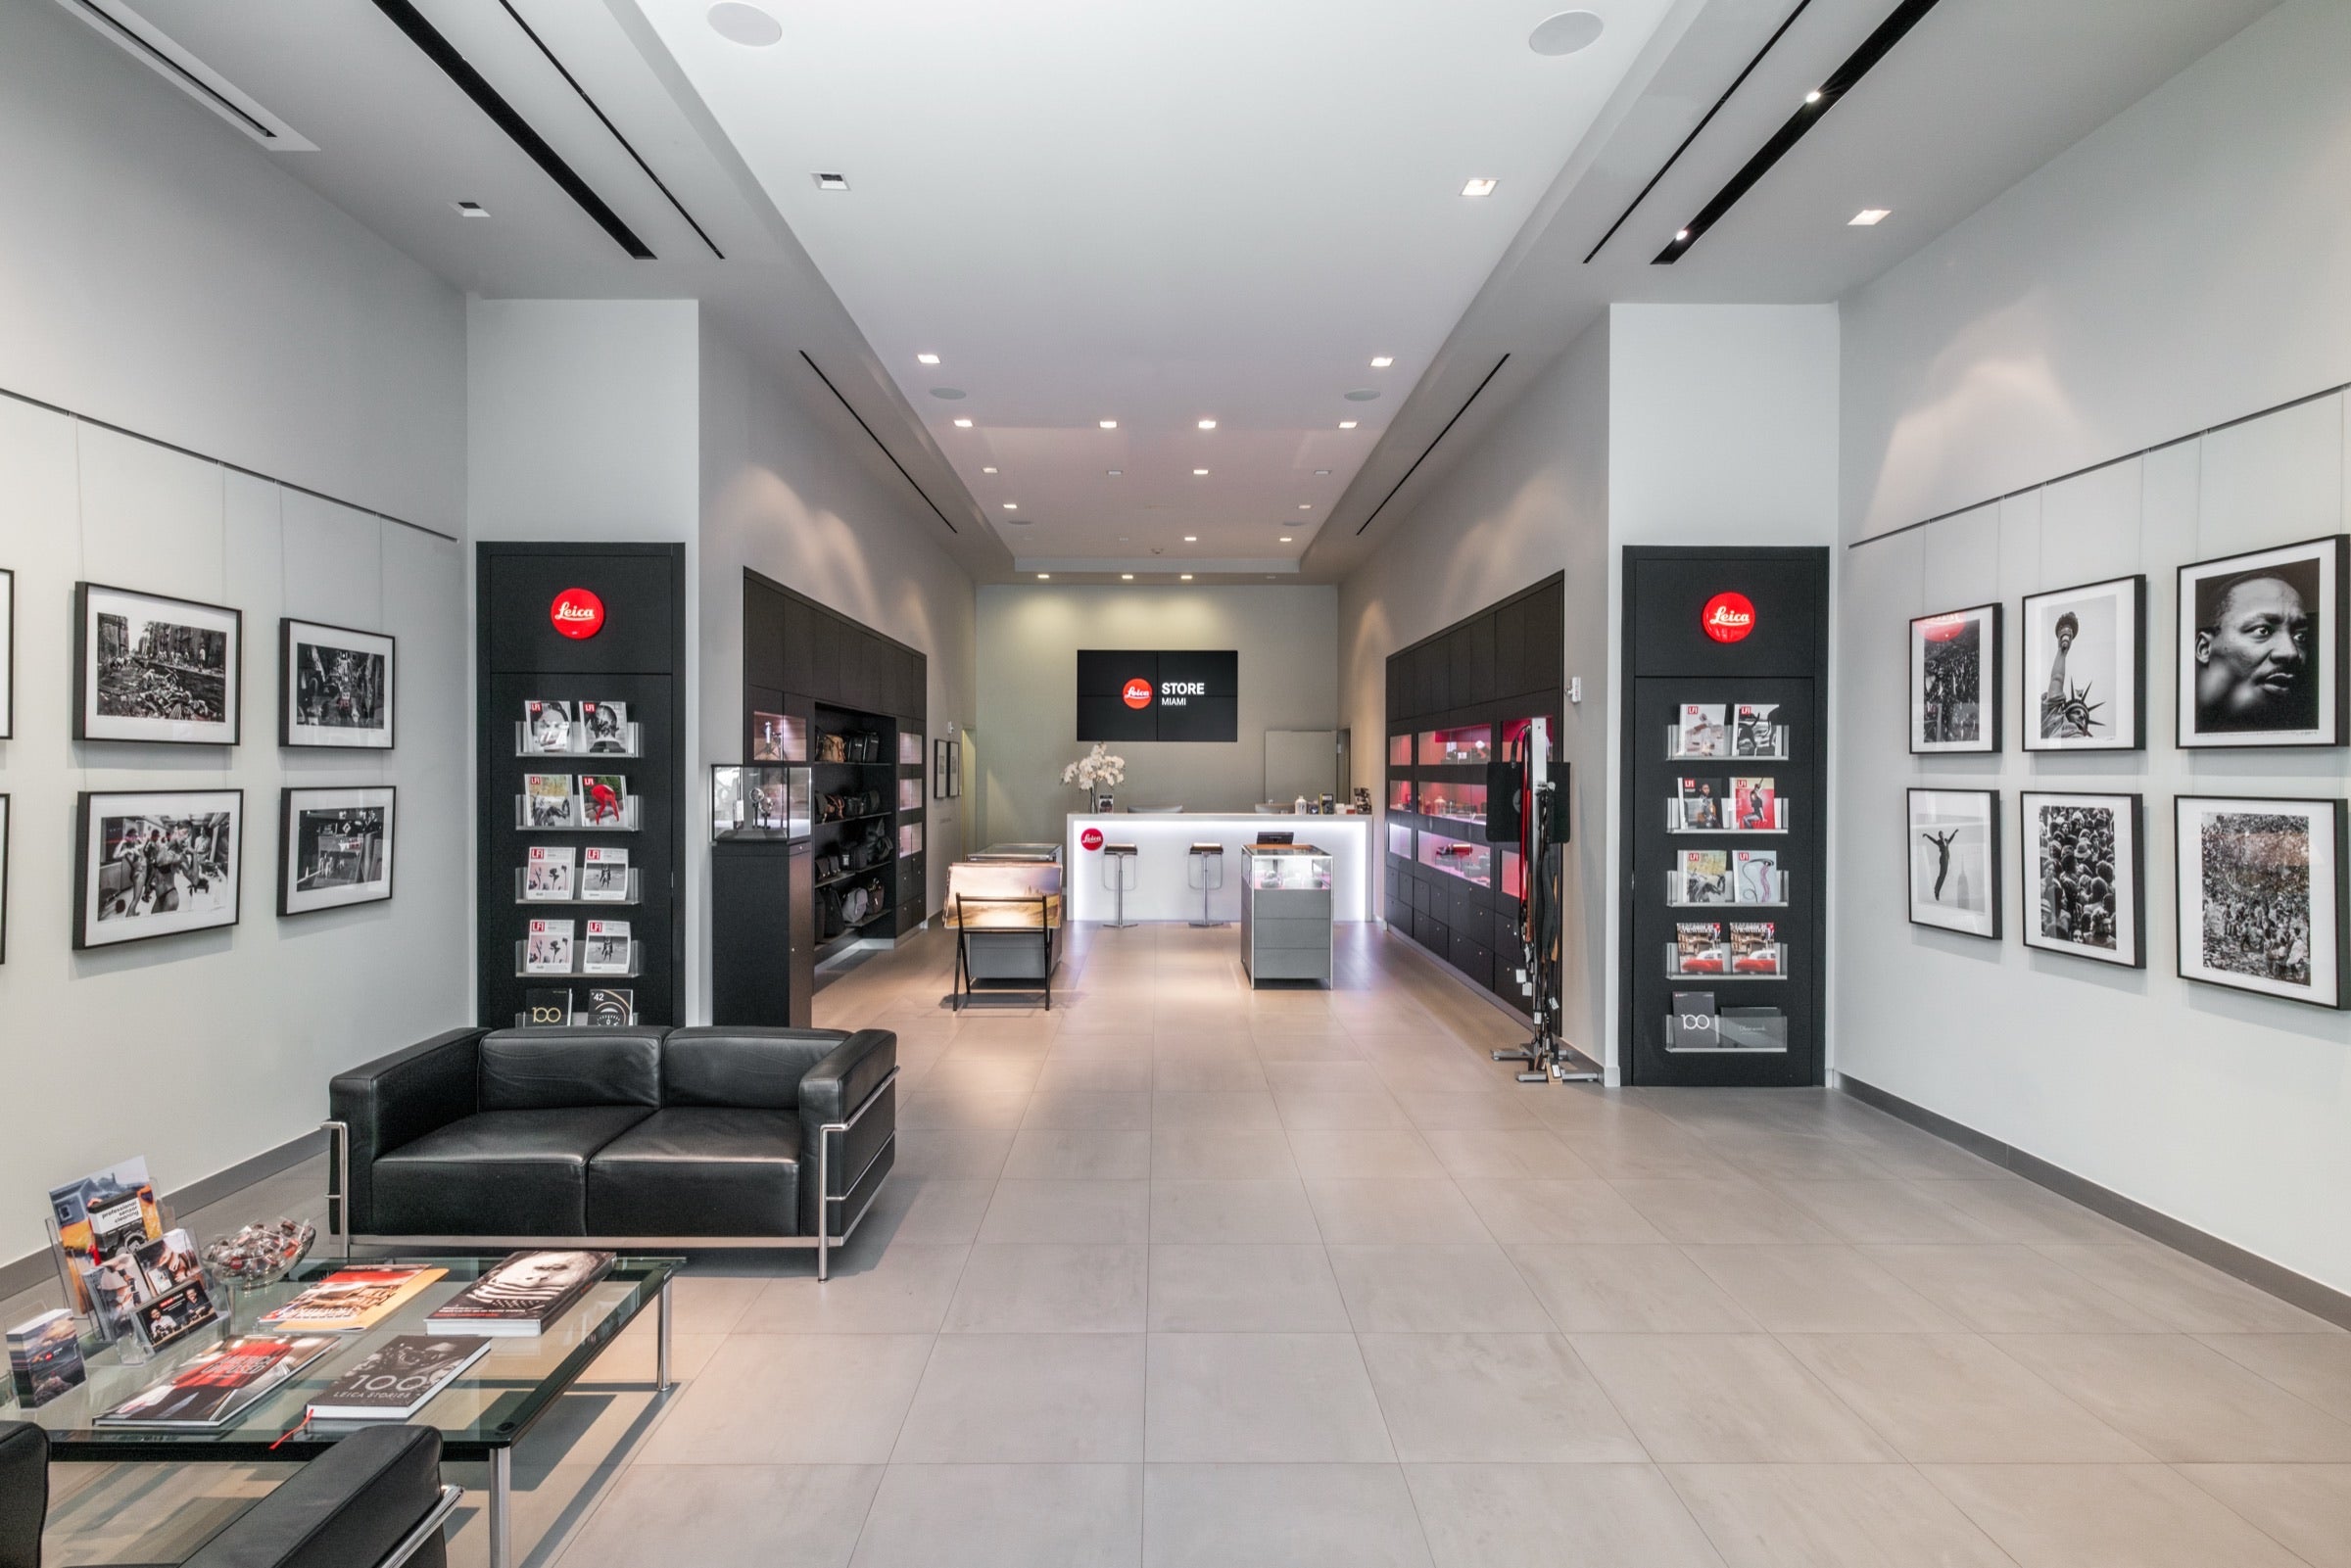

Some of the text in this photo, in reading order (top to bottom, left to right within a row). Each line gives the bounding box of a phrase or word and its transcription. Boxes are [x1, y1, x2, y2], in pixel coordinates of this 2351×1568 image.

[554, 601, 596, 622] Leica
[1709, 605, 1751, 628] Leica
[1124, 686, 1152, 700] Leica
[1161, 682, 1205, 695] STORE
[1161, 696, 1186, 706] MIAMI
[1081, 832, 1103, 844] Leica
[532, 849, 544, 859] LFI
[588, 850, 600, 860] LFI
[532, 922, 545, 931] LFI
[590, 923, 602, 932] LFI
[532, 1007, 561, 1022] 100
[1680, 1014, 1710, 1030] 100
[102, 1201, 137, 1219] professional
[119, 1207, 138, 1216] sensor
[115, 1211, 139, 1223] cleaning
[349, 1374, 428, 1392] 100
